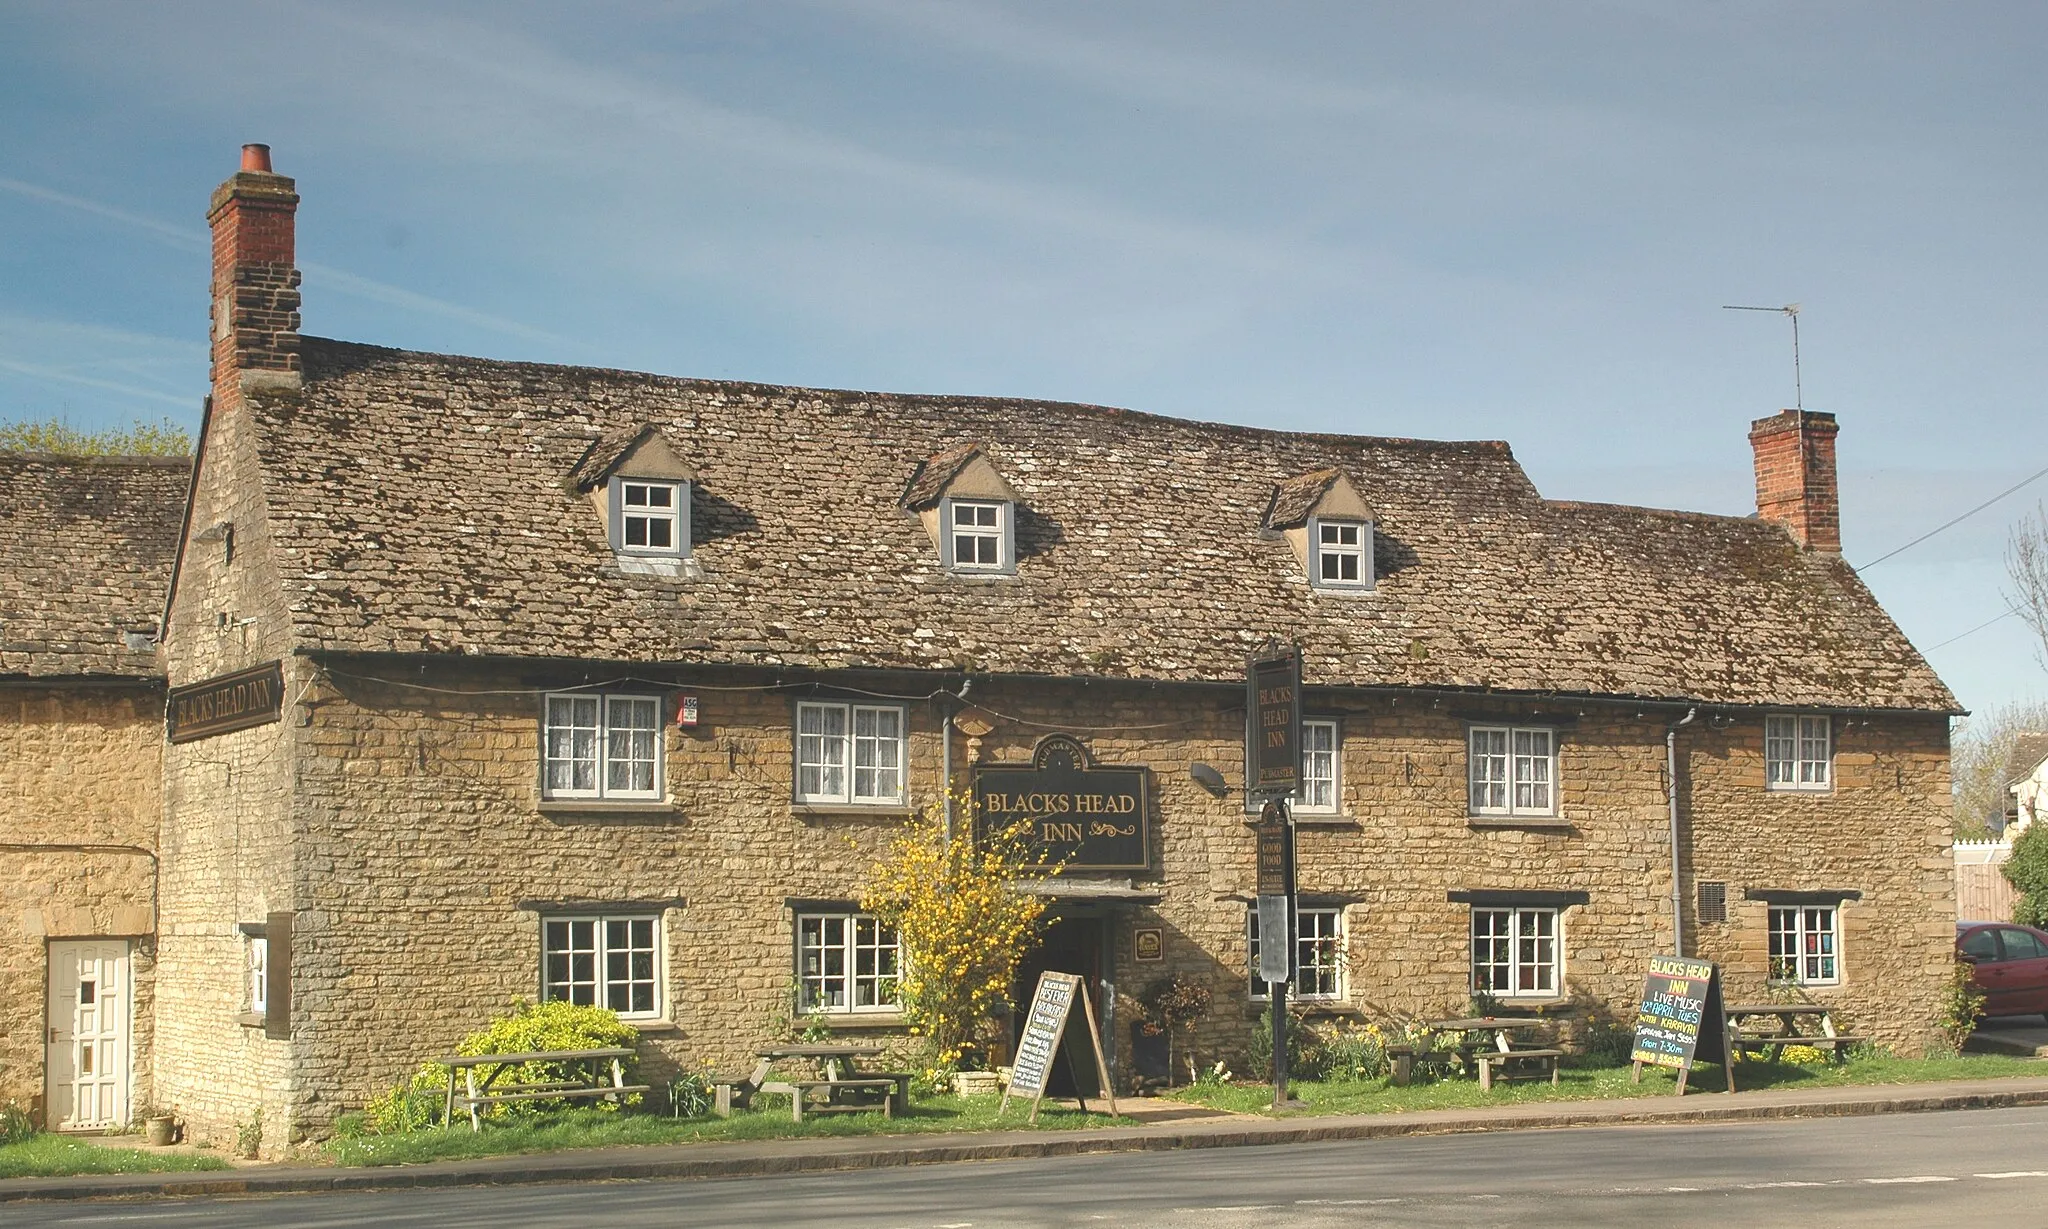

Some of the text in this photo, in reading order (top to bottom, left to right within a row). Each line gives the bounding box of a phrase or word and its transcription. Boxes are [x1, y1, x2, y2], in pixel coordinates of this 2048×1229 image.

[178, 678, 270, 726] BLACKS HEAD INN
[1259, 686, 1292, 705] BLACKS
[1263, 709, 1289, 727] HEAD
[1267, 730, 1285, 748] INN
[986, 793, 1135, 814] BLACKS HEAD
[1042, 823, 1082, 842] INN
[1262, 843, 1282, 853] GOOD
[1262, 855, 1282, 865] FOOD
[1649, 959, 1712, 980] BLACKS HEAD
[1669, 979, 1688, 994] INN
[1653, 991, 1702, 1013] LIVE MUSIC
[1651, 1002, 1675, 1019] APRIL
[1677, 1009, 1698, 1023] TUES
